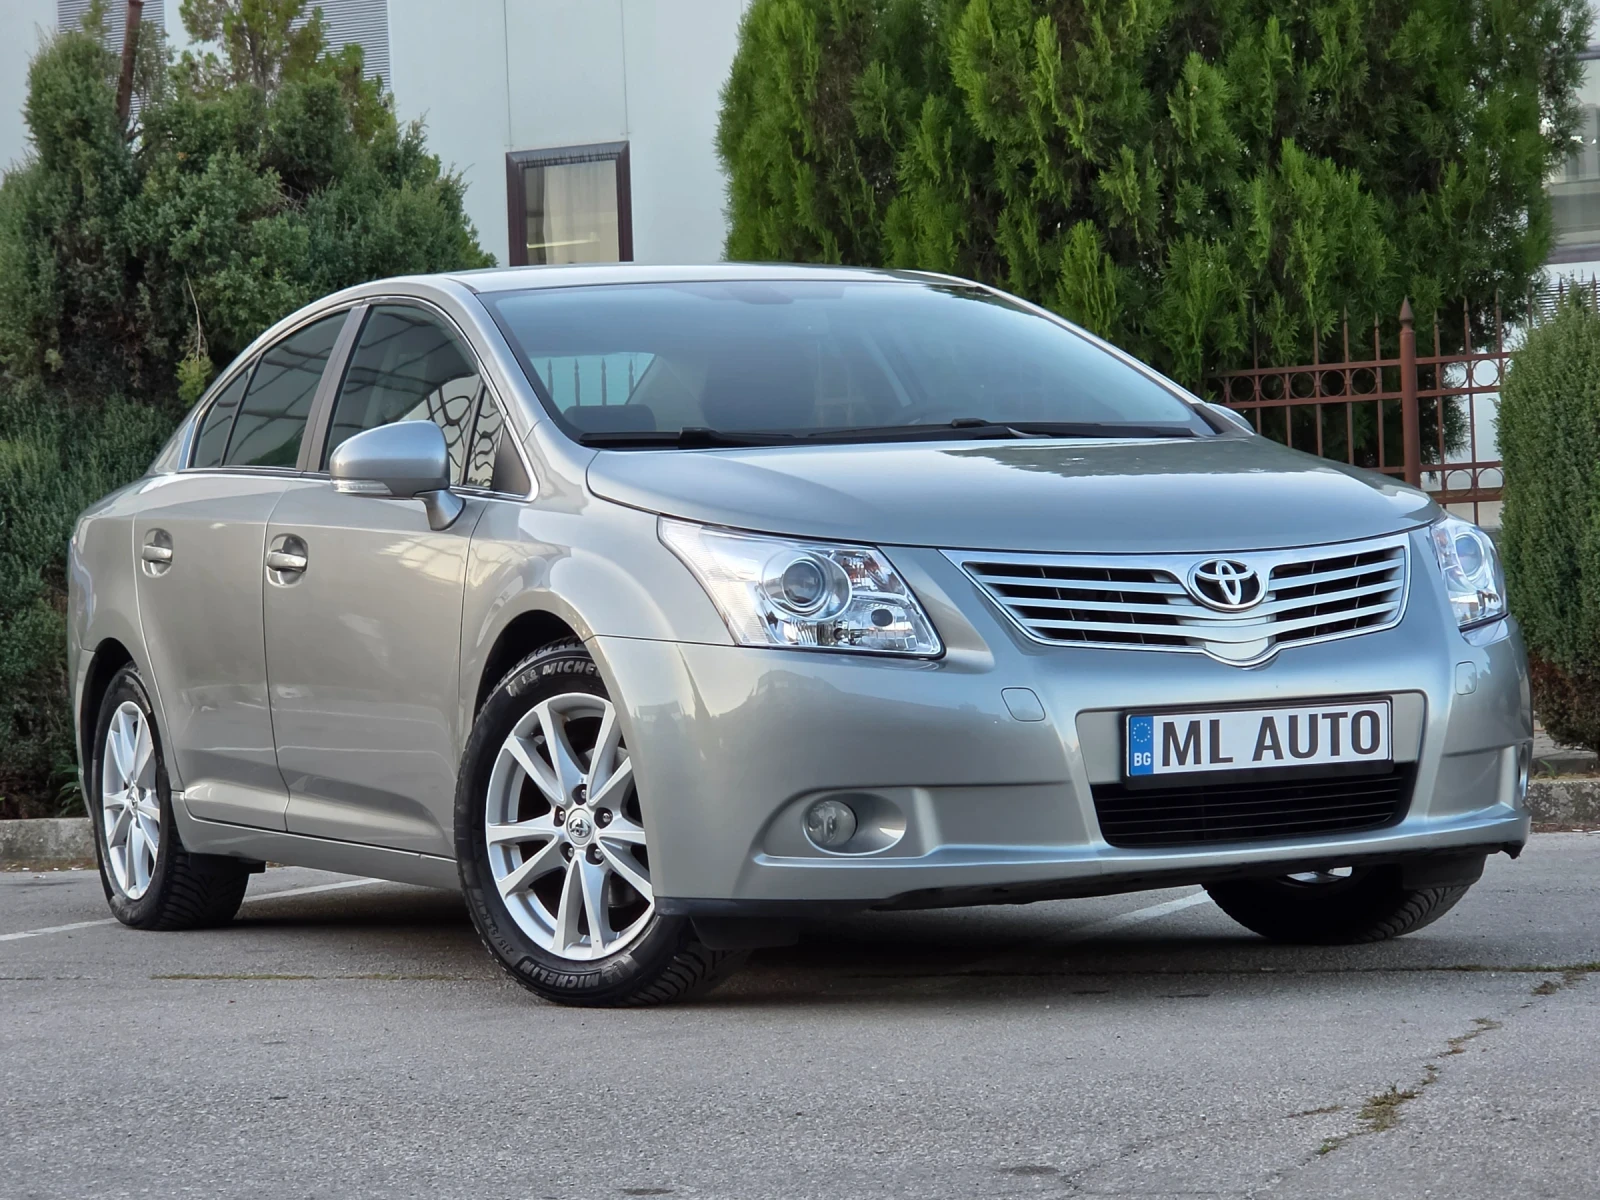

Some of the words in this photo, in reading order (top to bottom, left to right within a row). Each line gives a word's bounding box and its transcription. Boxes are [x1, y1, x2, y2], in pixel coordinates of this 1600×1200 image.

[1162, 719, 1234, 767] ML
[1252, 710, 1381, 762] AUTO
[1133, 752, 1151, 766] BG
[519, 960, 600, 989] MICHELIN
